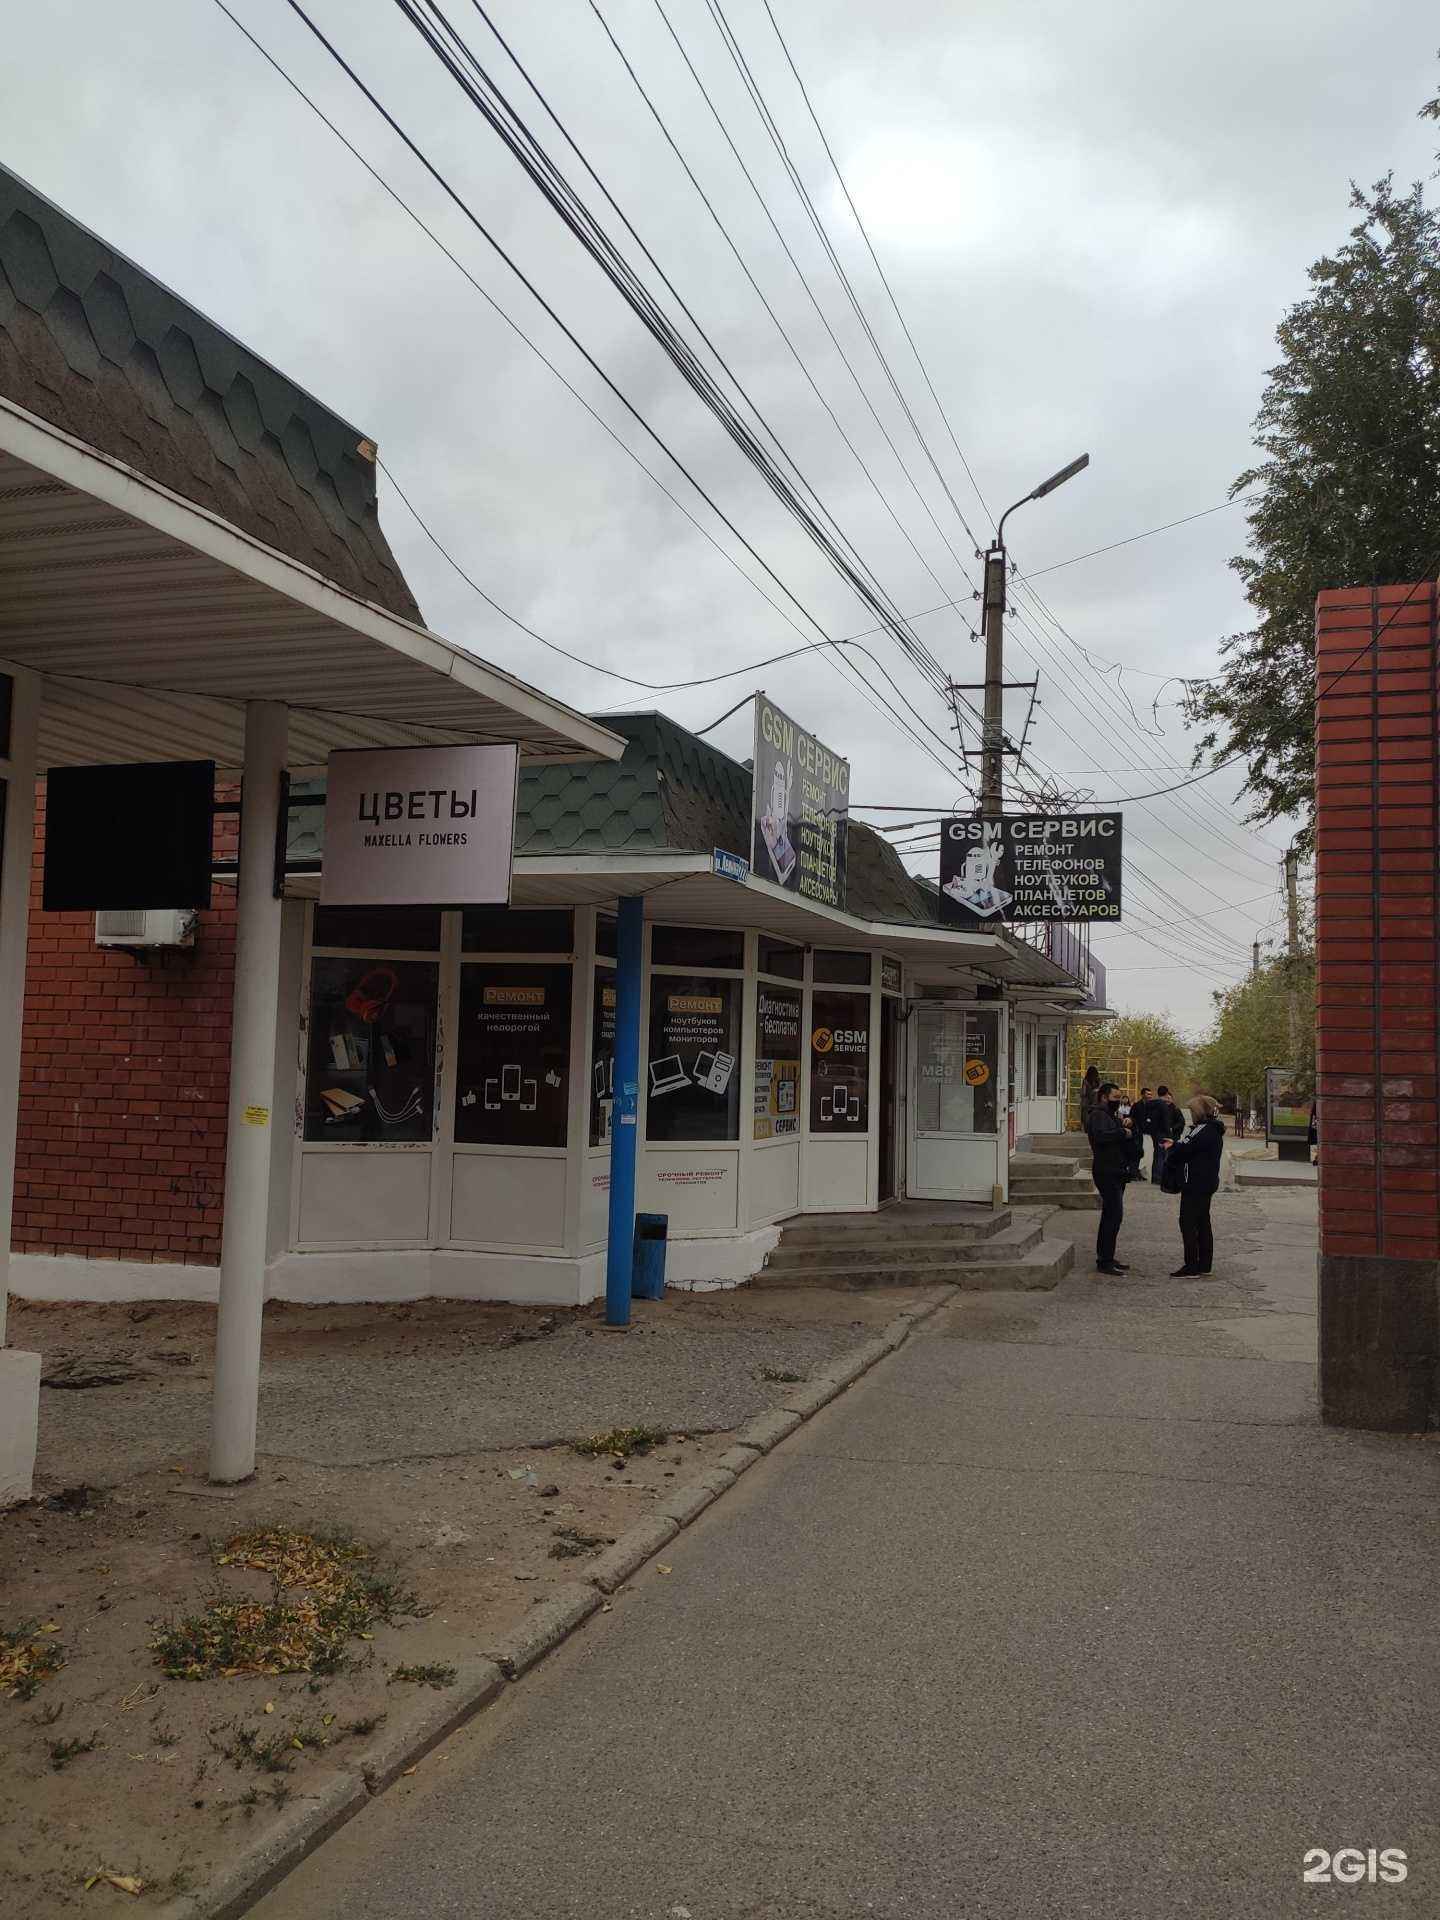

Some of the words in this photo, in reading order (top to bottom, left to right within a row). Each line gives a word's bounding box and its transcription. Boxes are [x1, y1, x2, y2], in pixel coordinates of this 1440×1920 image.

[761, 706, 793, 758] GSM
[798, 734, 847, 794] СЕРВИС
[802, 777, 826, 802] РЕМОНТ
[359, 789, 477, 826] ЦВЕТЫ
[949, 821, 1002, 840] GSM
[1010, 819, 1116, 839] СЕРВИС
[364, 834, 412, 847] MAXELLA
[418, 832, 467, 846] FLOWERS
[1015, 843, 1074, 856] РЕМОНТ
[1014, 859, 1105, 871] ТЕЛЕФОНОВ
[1014, 873, 1100, 886] НОУТБУКОВ
[1014, 889, 1106, 902] ПЛАНШЕТОВ
[1013, 904, 1120, 916] АКСЕССУАРОВ
[671, 1016, 717, 1026] ноутбуков
[663, 1026, 724, 1036] компьютеров
[834, 1030, 867, 1044] GSM
[669, 1035, 719, 1044] мониторов
[834, 1044, 867, 1053] SERVICE
